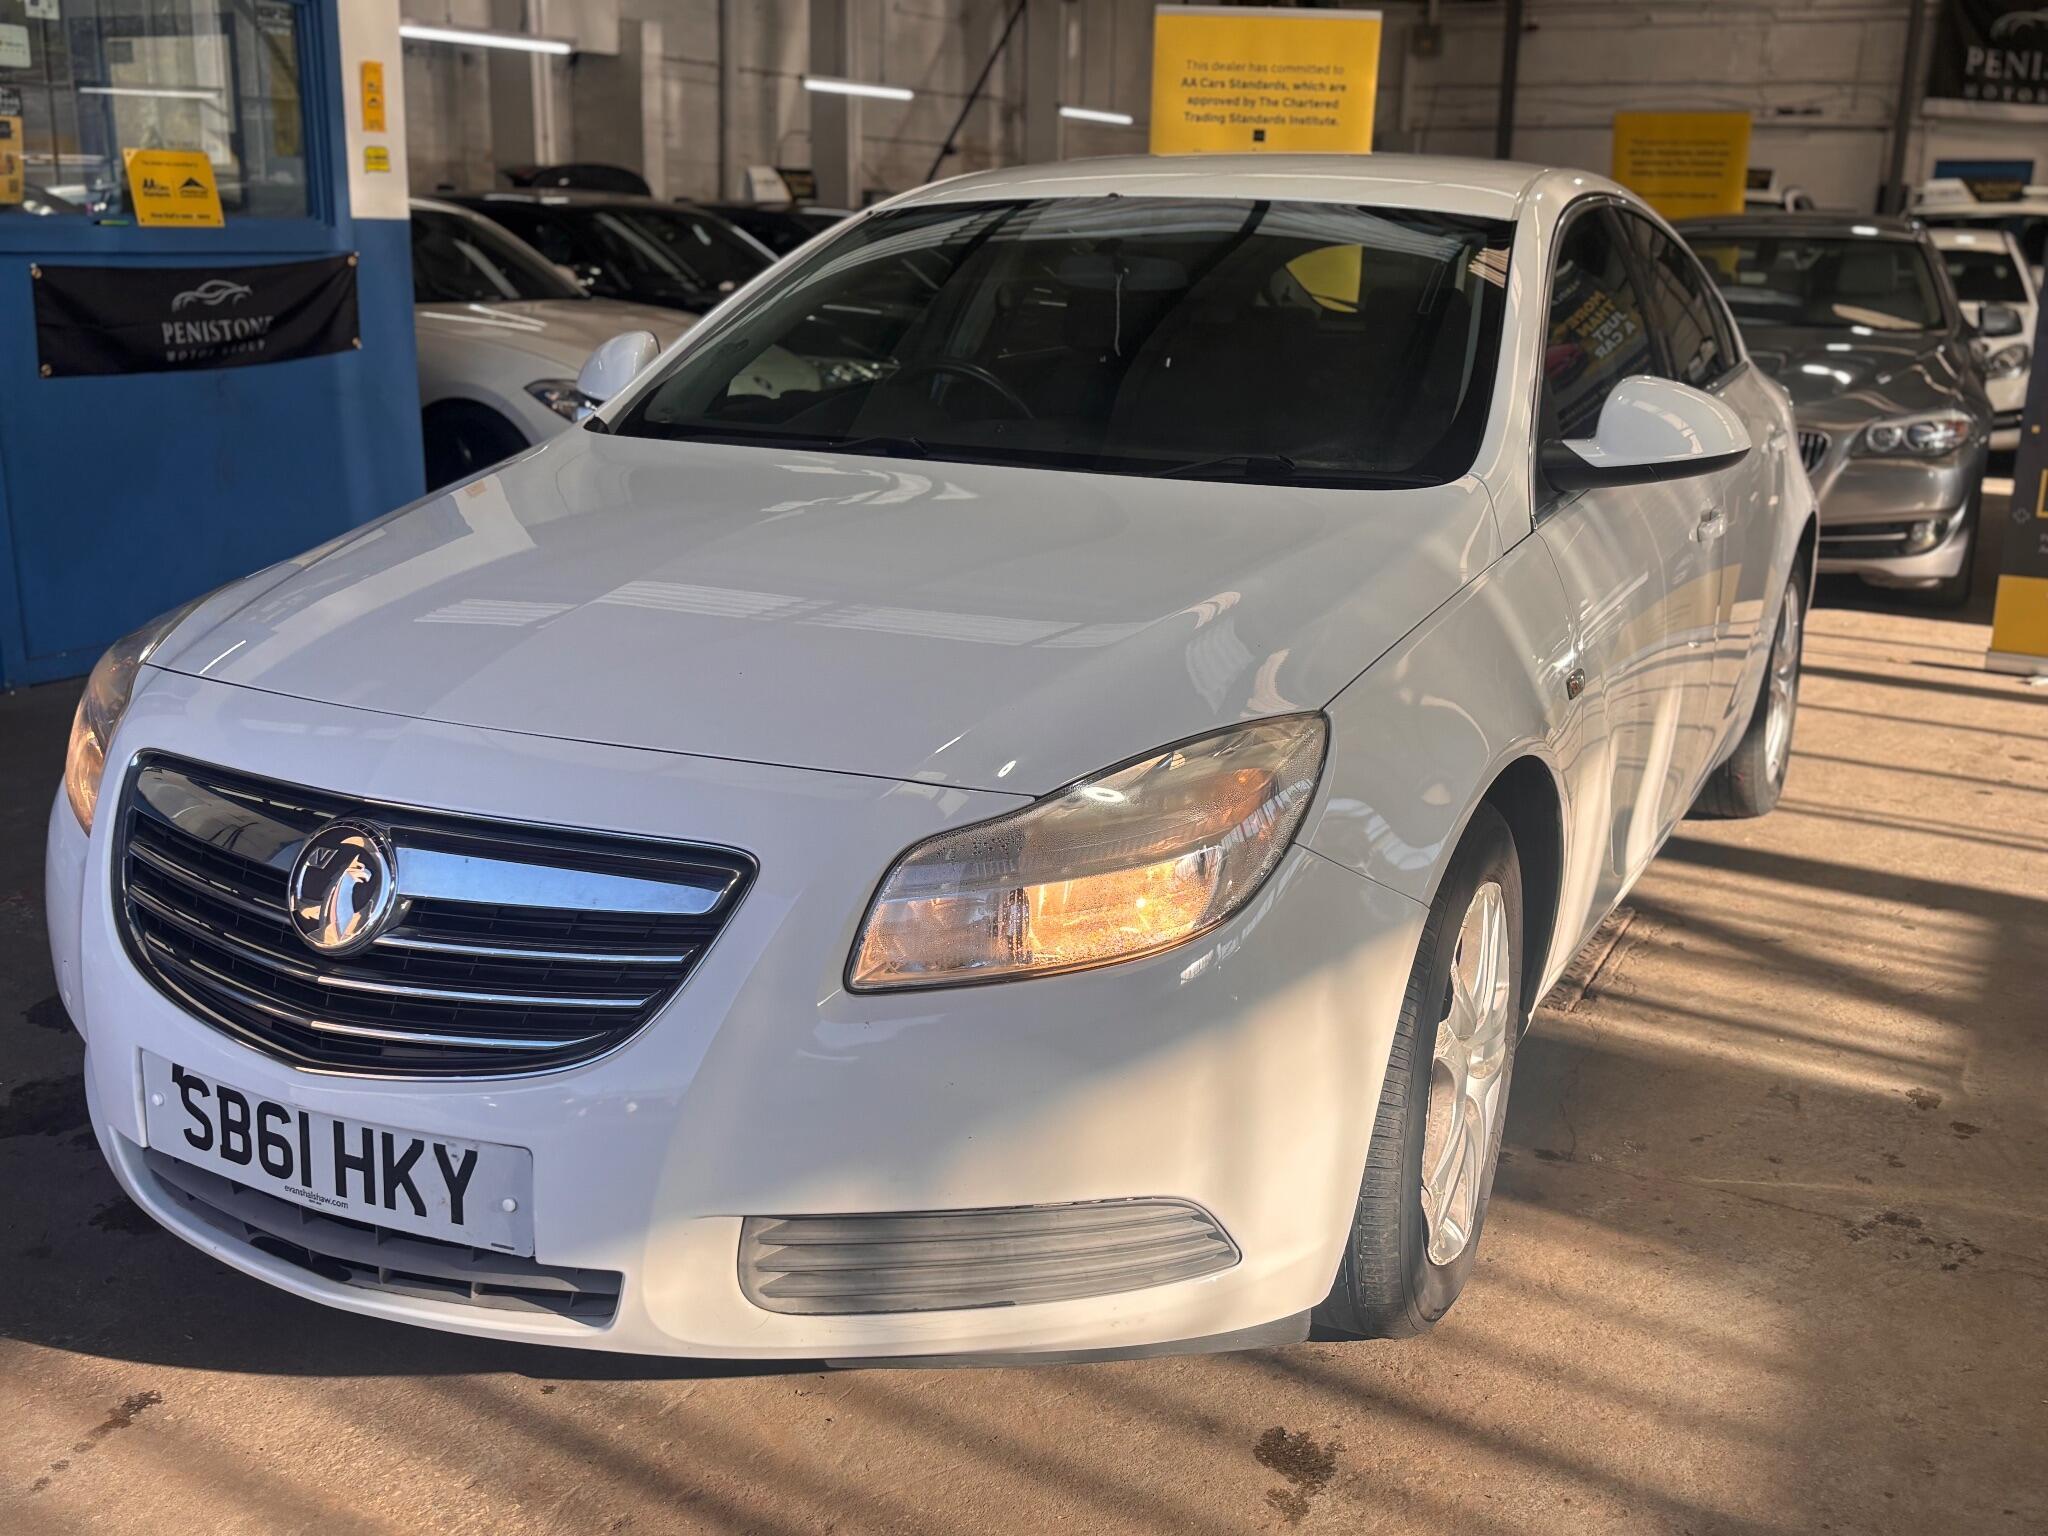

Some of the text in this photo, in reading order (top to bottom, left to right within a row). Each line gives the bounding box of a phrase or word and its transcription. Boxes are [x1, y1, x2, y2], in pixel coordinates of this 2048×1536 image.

[1187, 59, 1344, 75] This dealer has committed to
[1965, 46, 2048, 81] PENI
[1182, 77, 1346, 92] AA Cars Standards, which are
[1187, 96, 1339, 109] approved by The Chartered
[1184, 111, 1340, 126] Trading Standards Institute.
[173, 1064, 479, 1226] SB61 HKY
[284, 1185, 349, 1209] evanshalshaw.com
